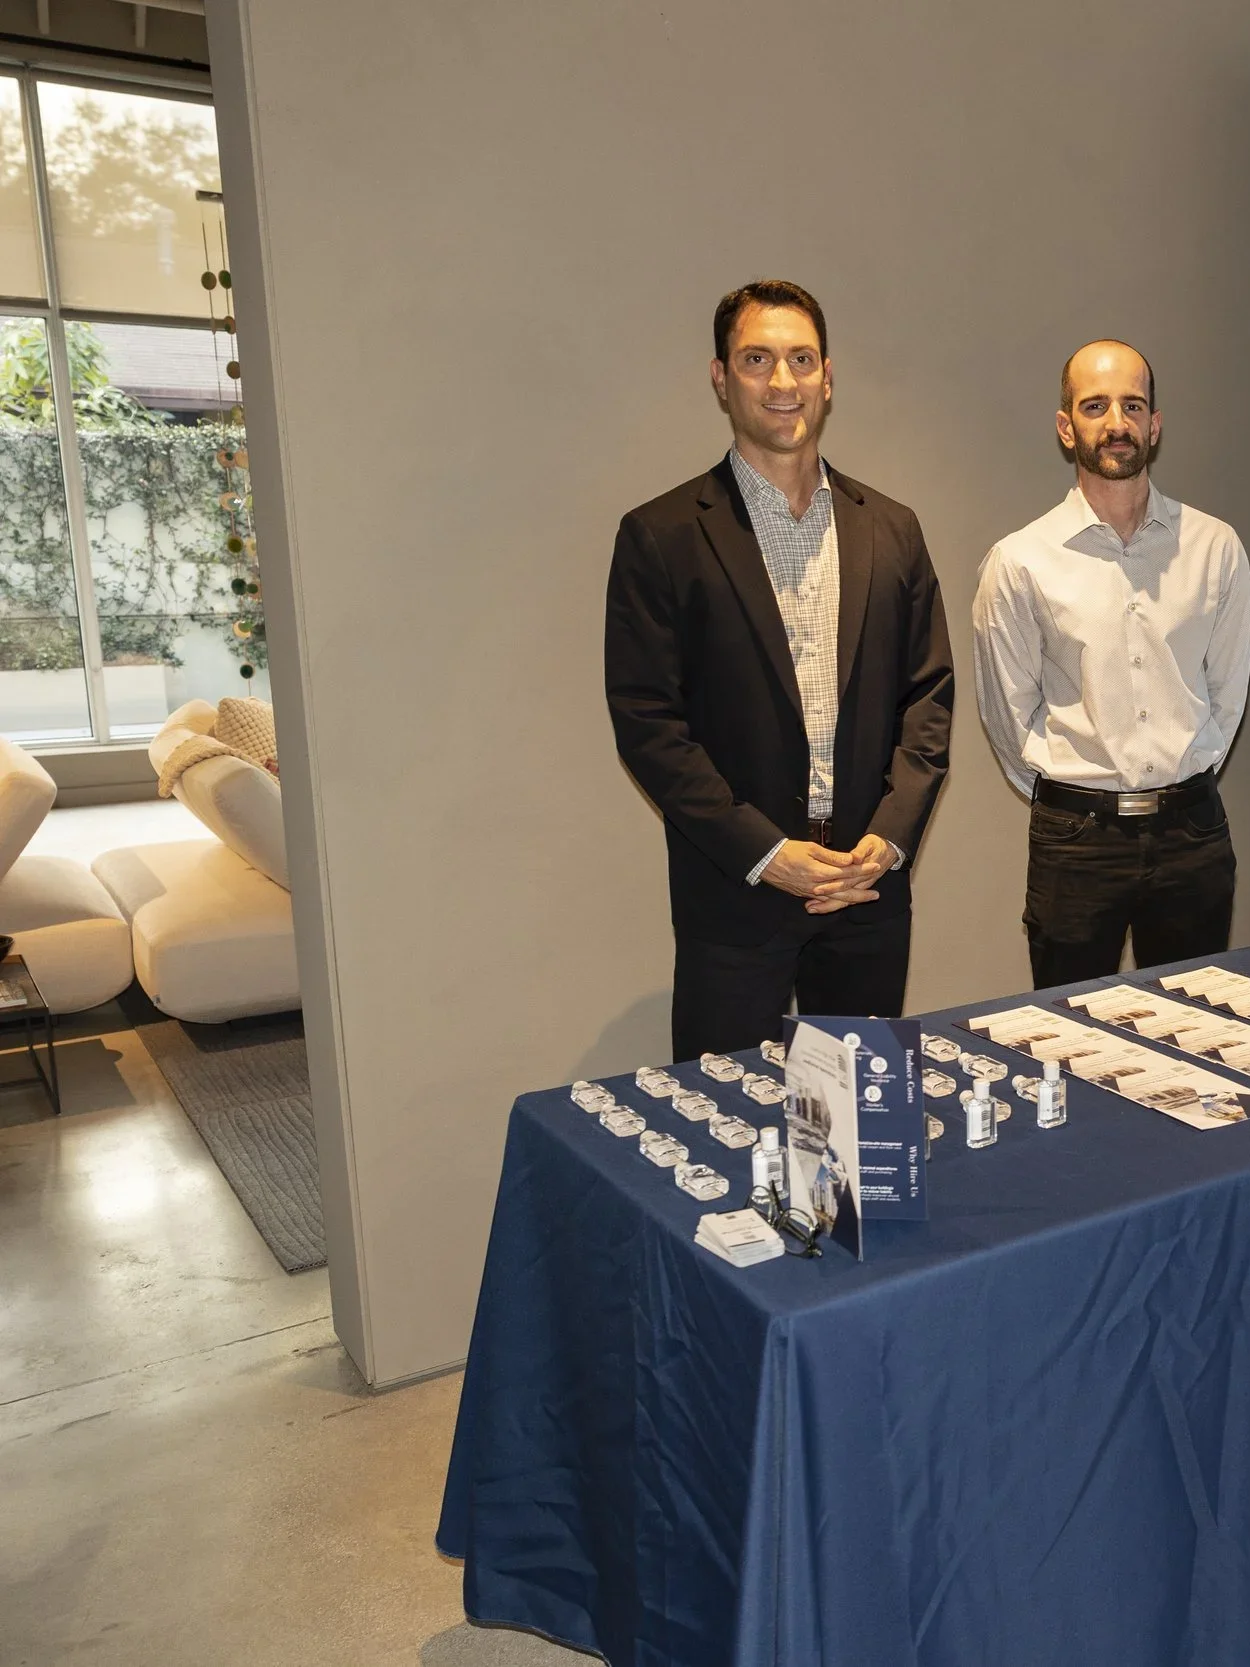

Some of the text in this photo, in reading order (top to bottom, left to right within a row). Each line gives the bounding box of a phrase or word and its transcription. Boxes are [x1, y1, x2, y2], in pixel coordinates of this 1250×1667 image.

[905, 1049, 916, 1103] Reduce Costs
[908, 1146, 919, 1197] Why Hire Us
